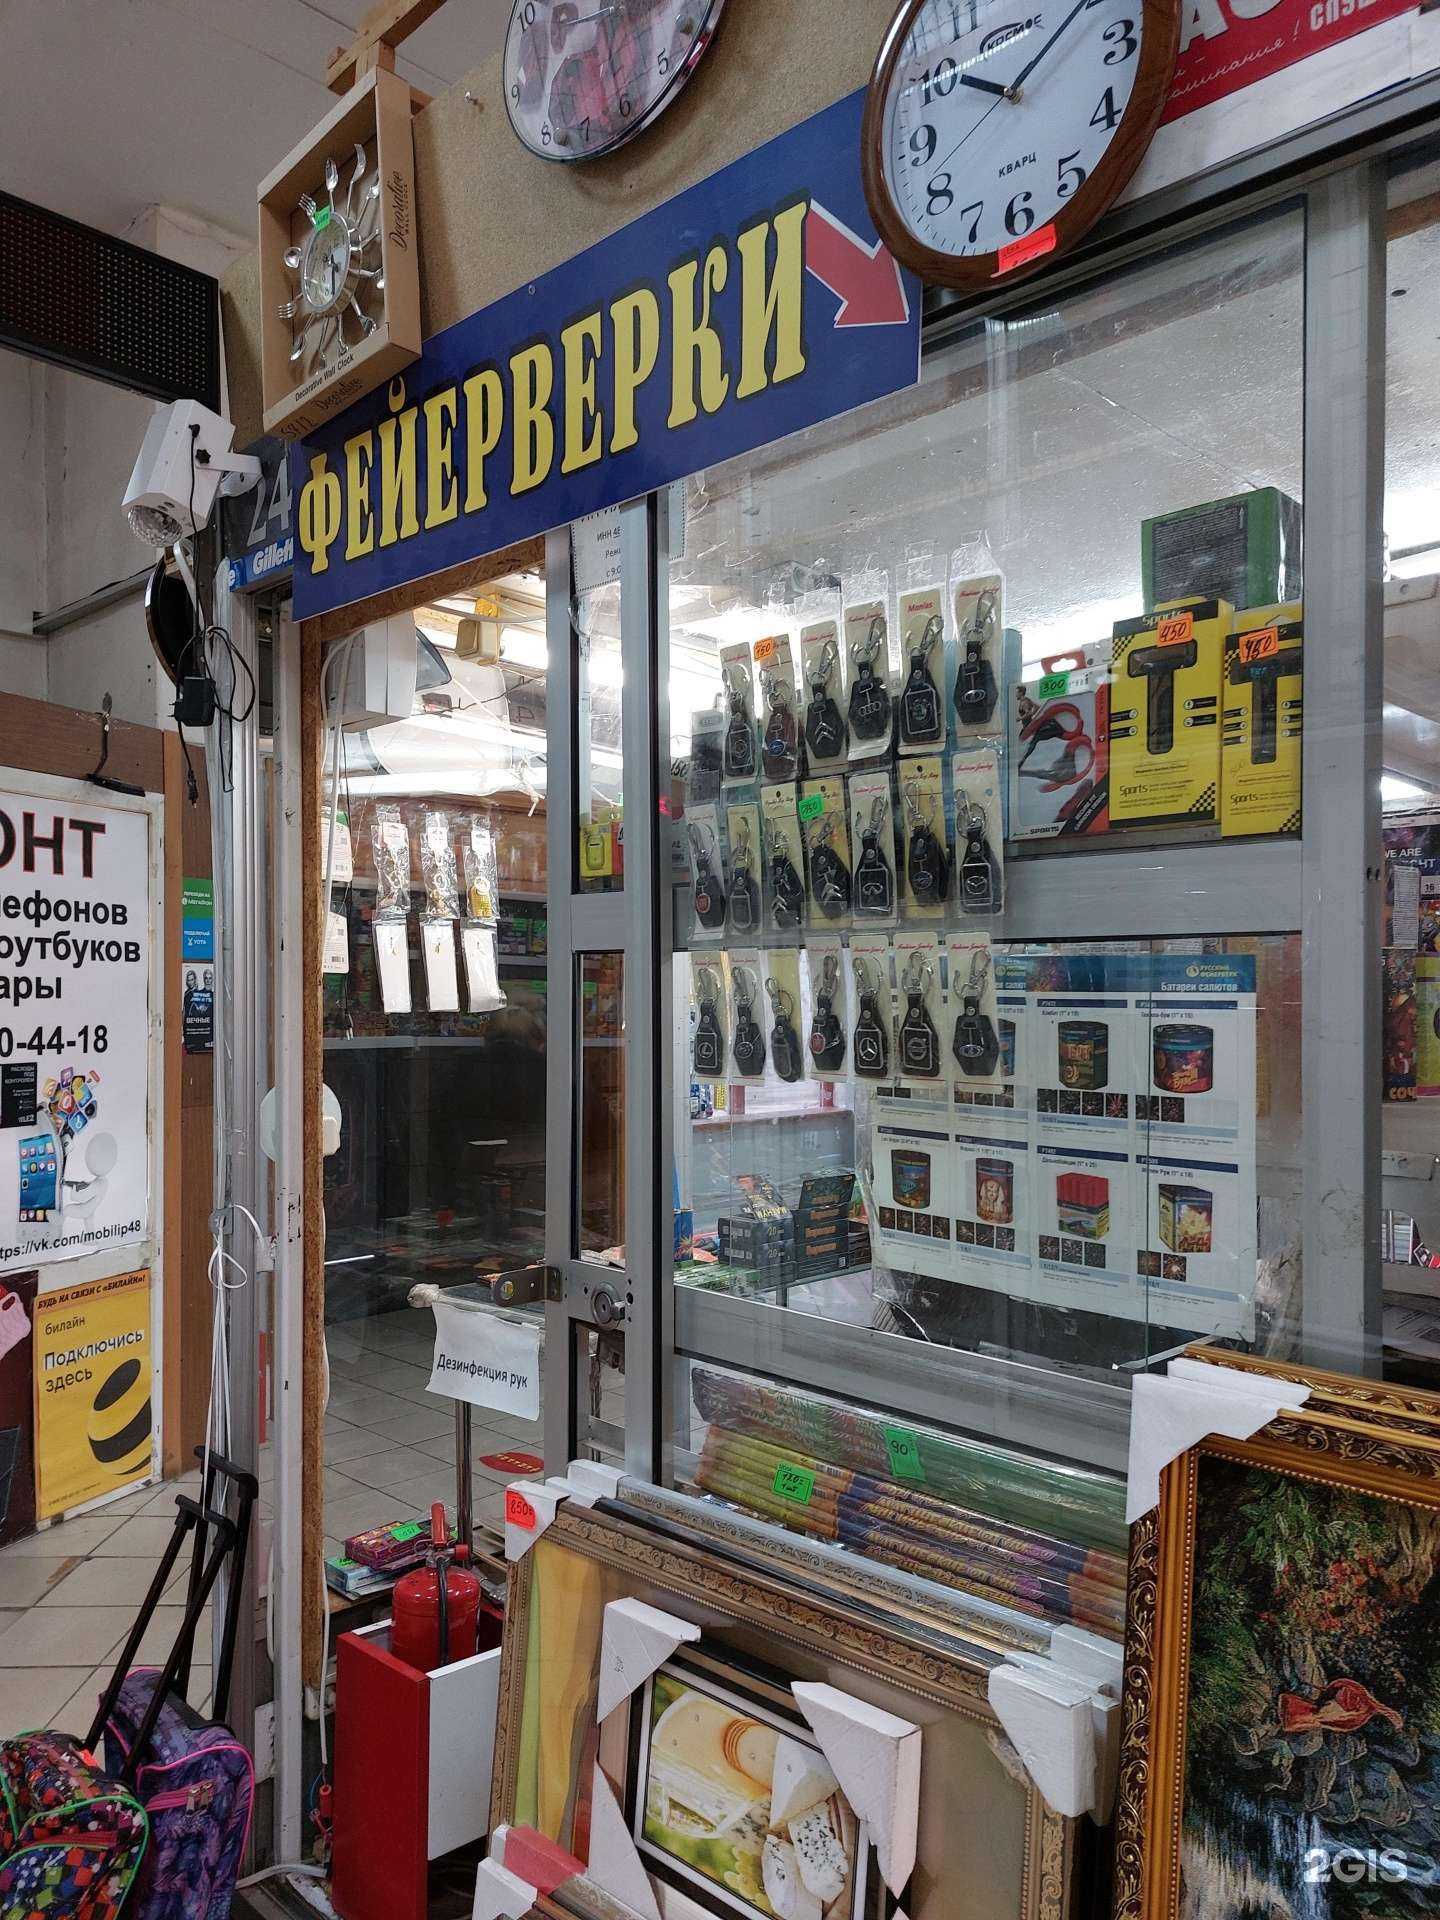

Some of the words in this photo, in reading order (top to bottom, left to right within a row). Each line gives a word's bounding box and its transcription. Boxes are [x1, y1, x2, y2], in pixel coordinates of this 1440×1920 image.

[516, 2, 536, 33] 10
[1103, 18, 1137, 65] 3
[657, 47, 669, 76] 5
[511, 84, 521, 108] 9
[908, 57, 958, 108] 10
[619, 93, 631, 118] 6
[1089, 86, 1123, 133] 4
[541, 123, 552, 146] 8
[580, 116, 591, 142] 7
[909, 123, 937, 167] 9
[998, 152, 1037, 179] КВАРЦ
[1056, 149, 1087, 198] 5
[926, 172, 954, 216] 8
[960, 200, 984, 243] 7
[1004, 191, 1035, 236] 6
[294, 377, 323, 402] Decorative
[323, 363, 337, 382] Wall
[337, 353, 355, 372] Clock
[298, 199, 807, 576] ФЕЙЕРВЕРКИ
[1119, 784, 1148, 799] Sports
[1229, 792, 1259, 806] Sports
[1398, 847, 1423, 859] ARE
[1161, 982, 1197, 993] Батареи
[1198, 983, 1239, 992] салютов
[59, 1295, 70, 1304] НА
[71, 1287, 96, 1302] СВЯЗИ
[45, 1315, 86, 1336] билайн
[44, 1330, 143, 1371] Подключись
[45, 1367, 93, 1394] здесь
[437, 1354, 508, 1384] Дезинфекция
[510, 1374, 528, 1390] рук
